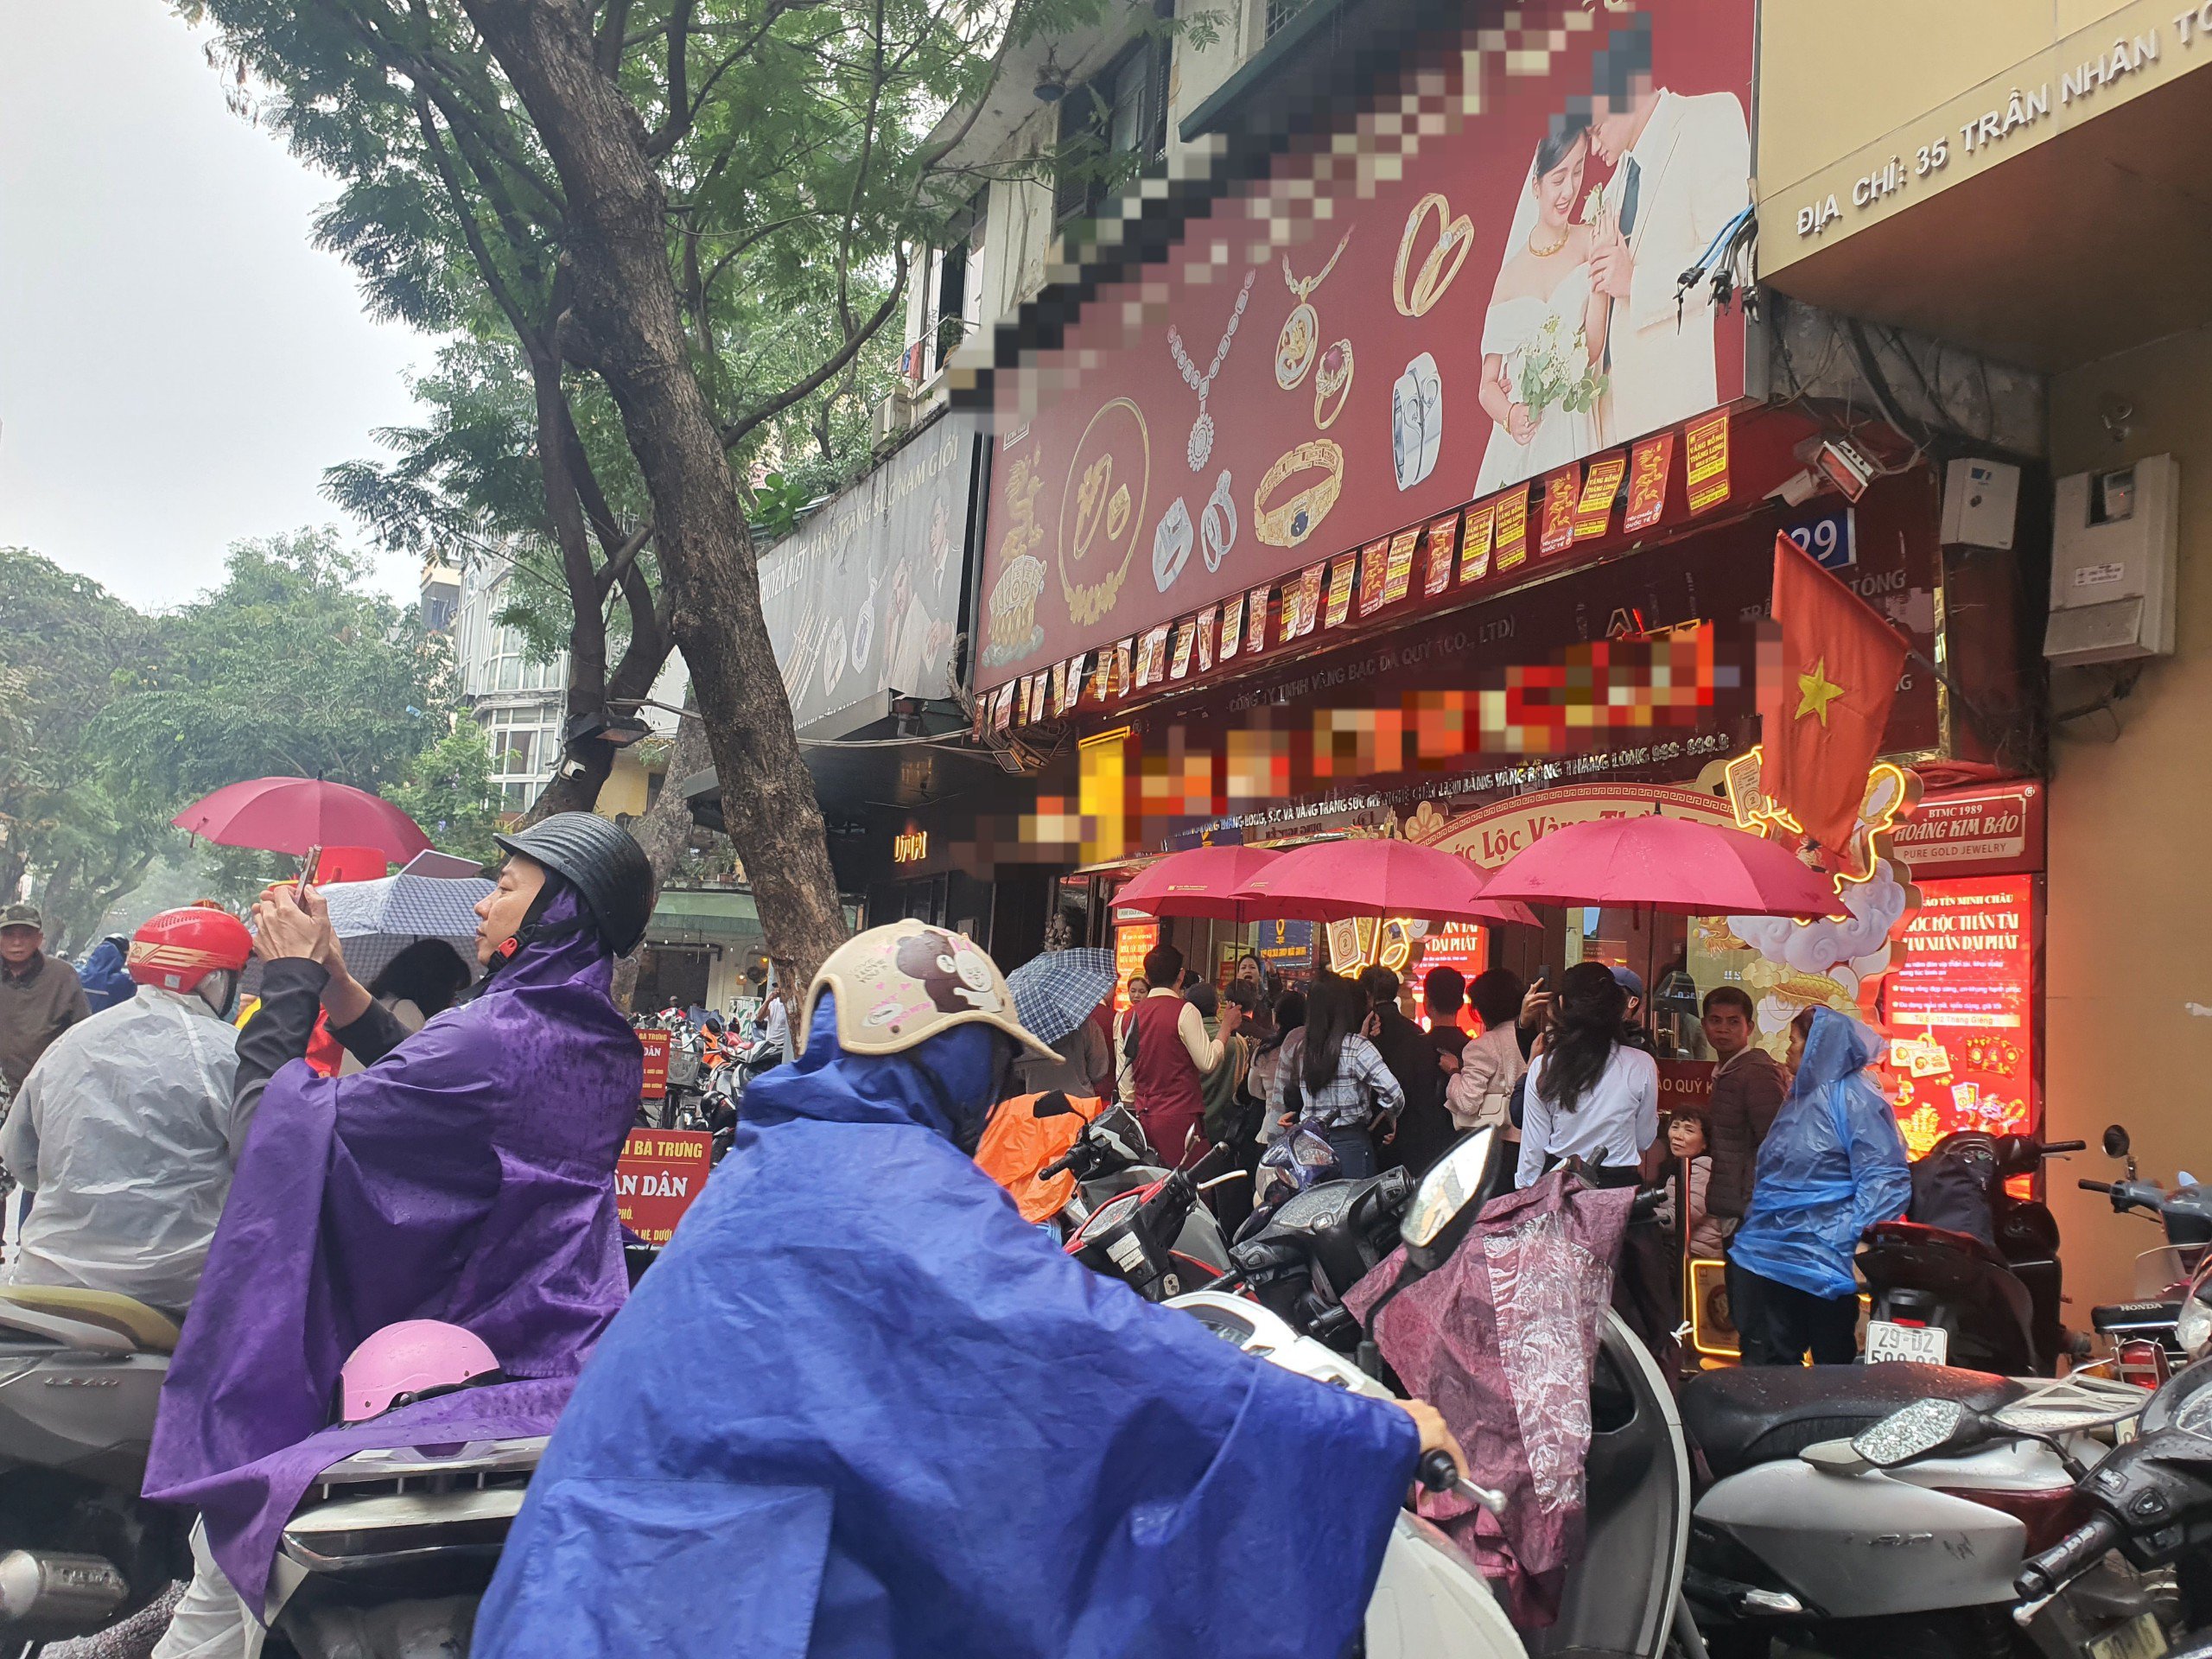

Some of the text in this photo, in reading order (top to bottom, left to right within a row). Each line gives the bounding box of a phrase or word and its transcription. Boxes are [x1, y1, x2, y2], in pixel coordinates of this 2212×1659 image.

[1796, 193, 1841, 235] ĐỊA
[1852, 156, 1906, 208] CHỈ:
[1916, 137, 1948, 177] 35
[1960, 84, 2050, 152] TRẦN
[2061, 29, 2160, 104] NHÂN
[838, 499, 872, 542] TRANG
[898, 460, 925, 501] NAM
[929, 434, 959, 478] GIỚI
[1278, 677, 1309, 702] TNHH
[1479, 614, 1516, 644] LTD)
[1284, 804, 1294, 821] VÀ
[1296, 803, 1319, 820] VÀNG
[1319, 798, 1348, 816] TRANG
[1495, 766, 1527, 788] VÀNG
[1564, 753, 1610, 776] THĂNG
[1611, 747, 1650, 767] LONG
[1928, 804, 1983, 818] BTMC 1989
[1894, 810, 2019, 842] HOÀNG KIM BẢO
[1482, 828, 1522, 862] Lộc
[1904, 842, 2006, 859] PURE GOLD JEWELRY
[1923, 896, 1939, 907] ẢO
[1957, 894, 1984, 906] MINH
[1985, 893, 2014, 905] CHÂU
[1932, 913, 1958, 933] LỘC
[1958, 911, 1996, 931] THẦN
[1431, 934, 1478, 954] ĐẠI PHÁT
[1985, 931, 2020, 950] PHÁT
[643, 1045, 662, 1057] DÂN
[1675, 1077, 1703, 1094] QUÝ
[633, 1138, 653, 1156] BÀ
[657, 1140, 703, 1160] TRƯNG
[640, 1170, 689, 1198] DÂN
[2120, 1302, 2164, 1312] HONDA
